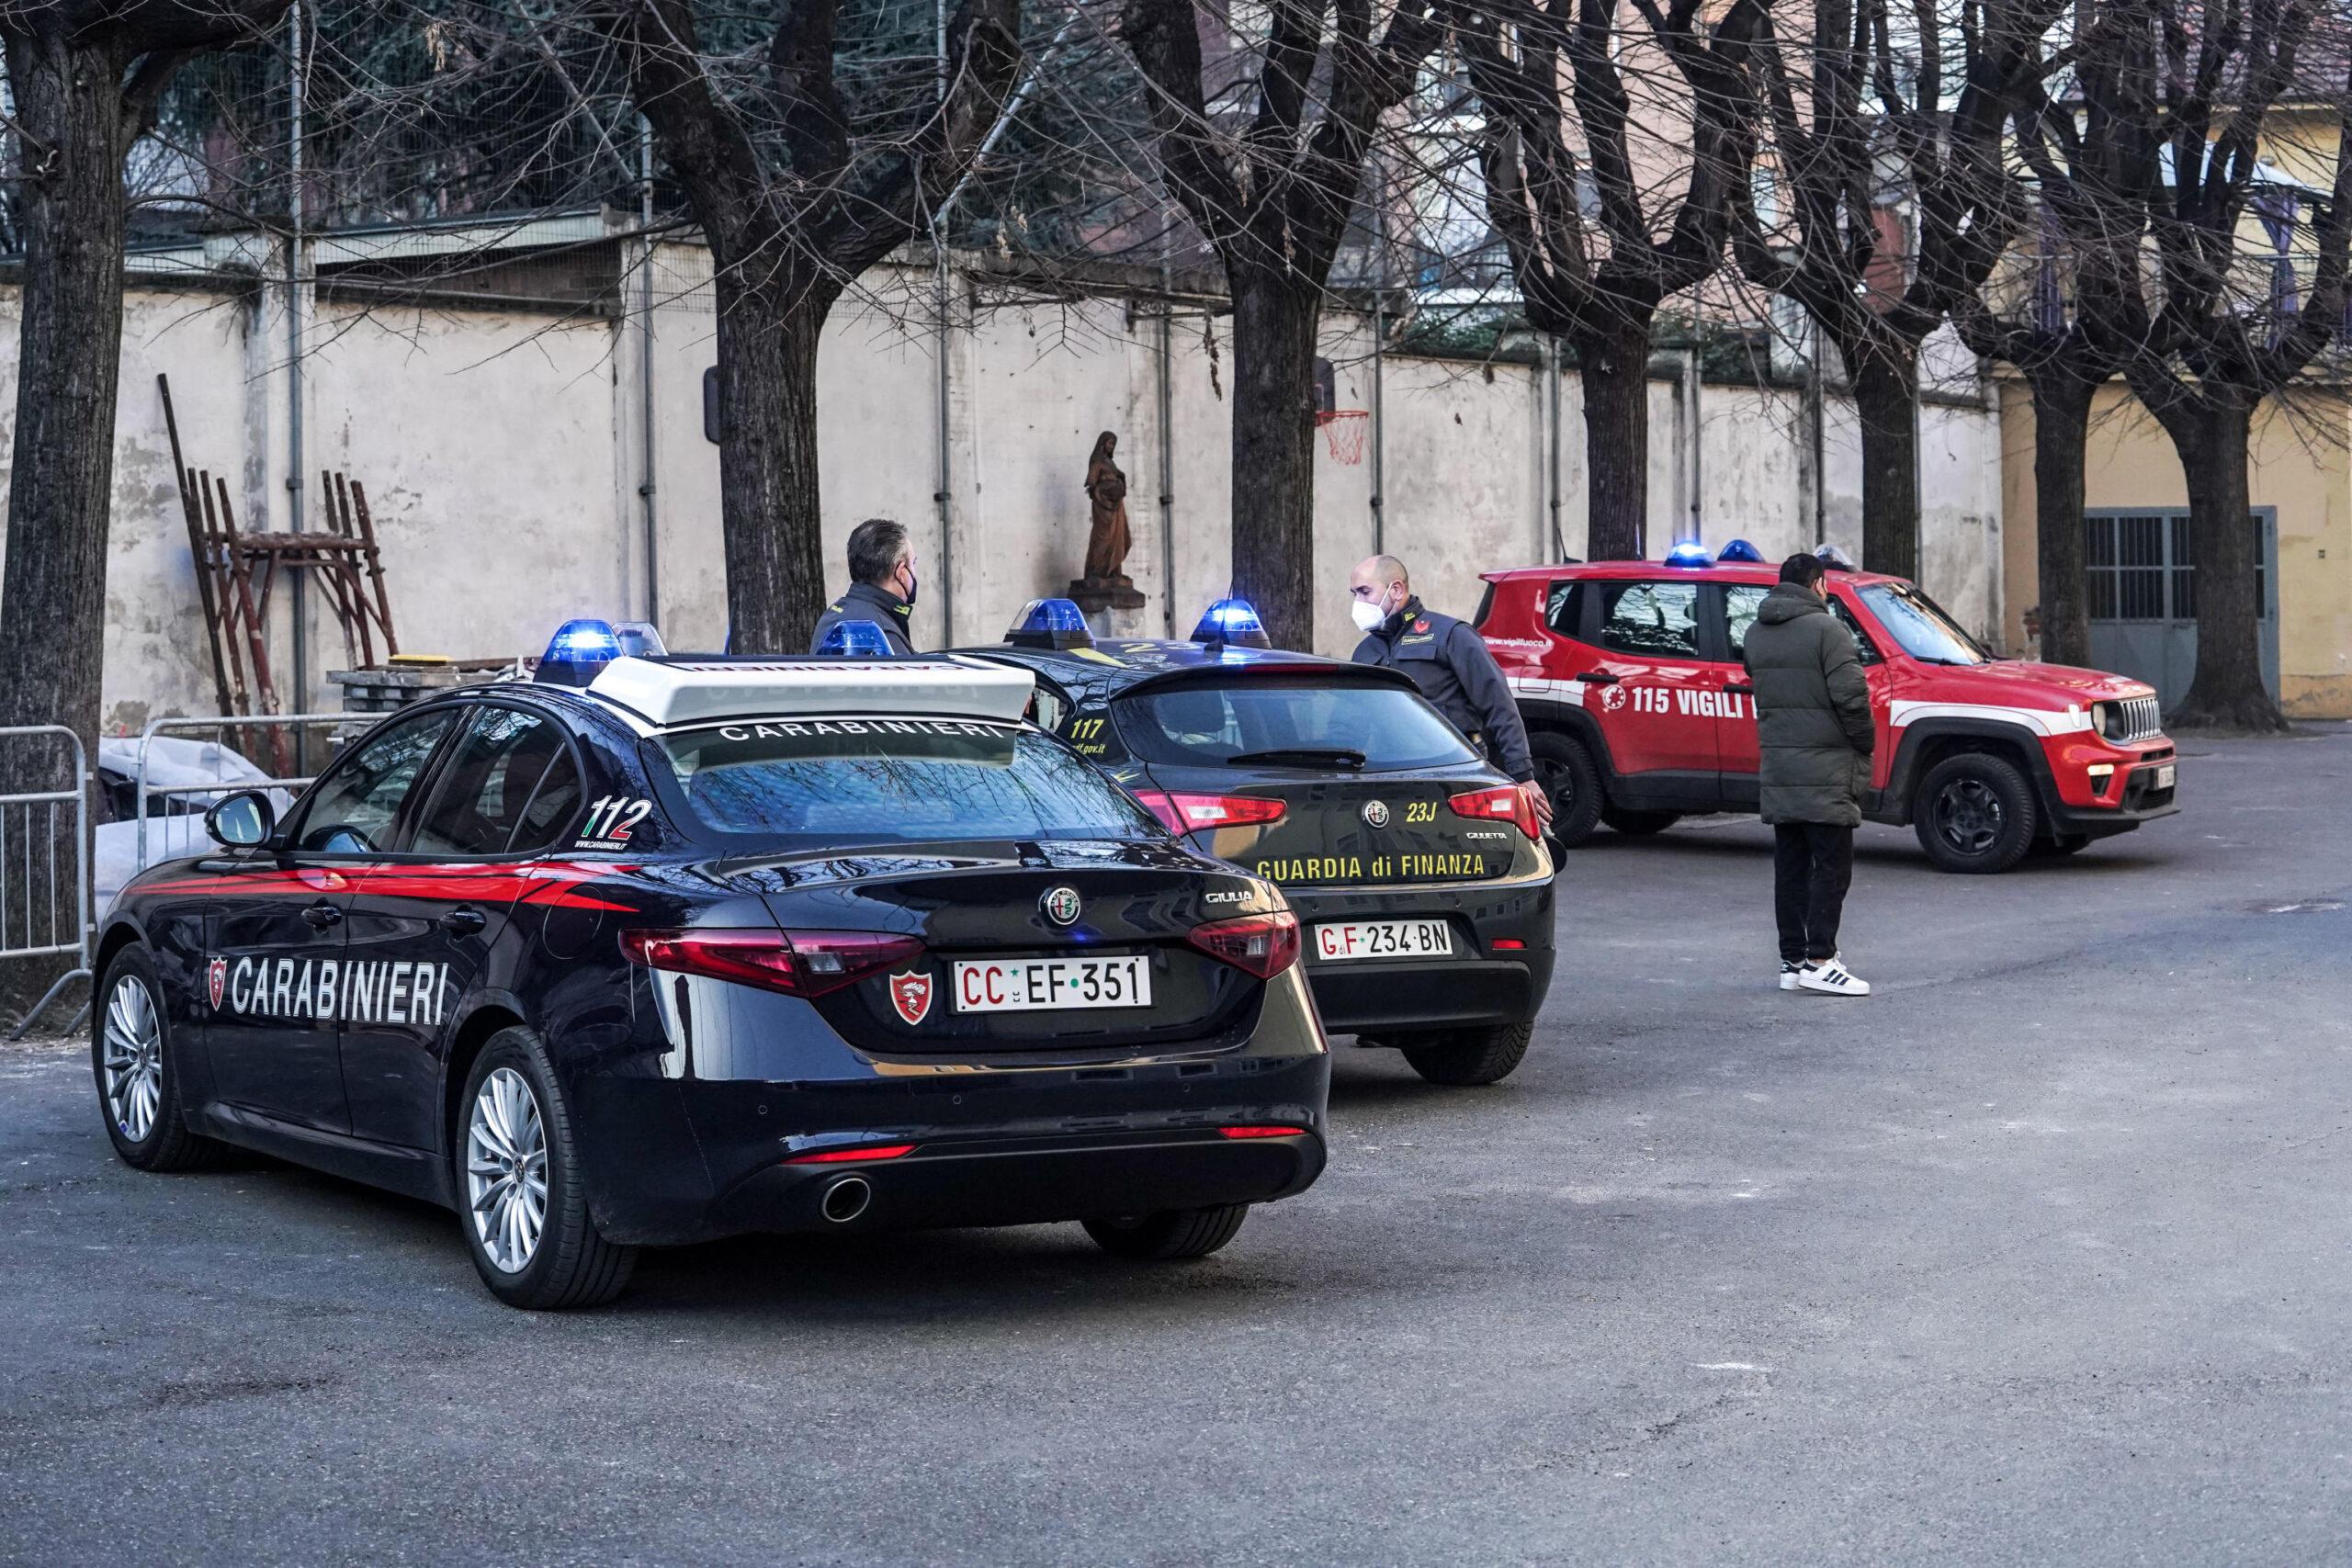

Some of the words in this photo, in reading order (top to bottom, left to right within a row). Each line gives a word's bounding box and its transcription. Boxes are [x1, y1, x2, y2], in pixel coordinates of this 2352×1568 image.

[1632, 687, 1669, 714] 115
[1676, 689, 1744, 718] VIGILI
[718, 719, 1005, 741] CARABINIERI
[1070, 719, 1103, 739] 117
[581, 795, 652, 840] 112
[1407, 802, 1437, 822] 23J
[1257, 857, 1362, 881] GUARDIA
[1372, 855, 1392, 877] di
[1402, 855, 1485, 877] FINANZA
[1205, 890, 1253, 903] GIULIA
[1367, 925, 1411, 953] 234
[1418, 924, 1448, 952] BN
[232, 956, 448, 1025] CARABINIERI
[963, 965, 1004, 1006] CC
[1081, 963, 1138, 1001] 351
